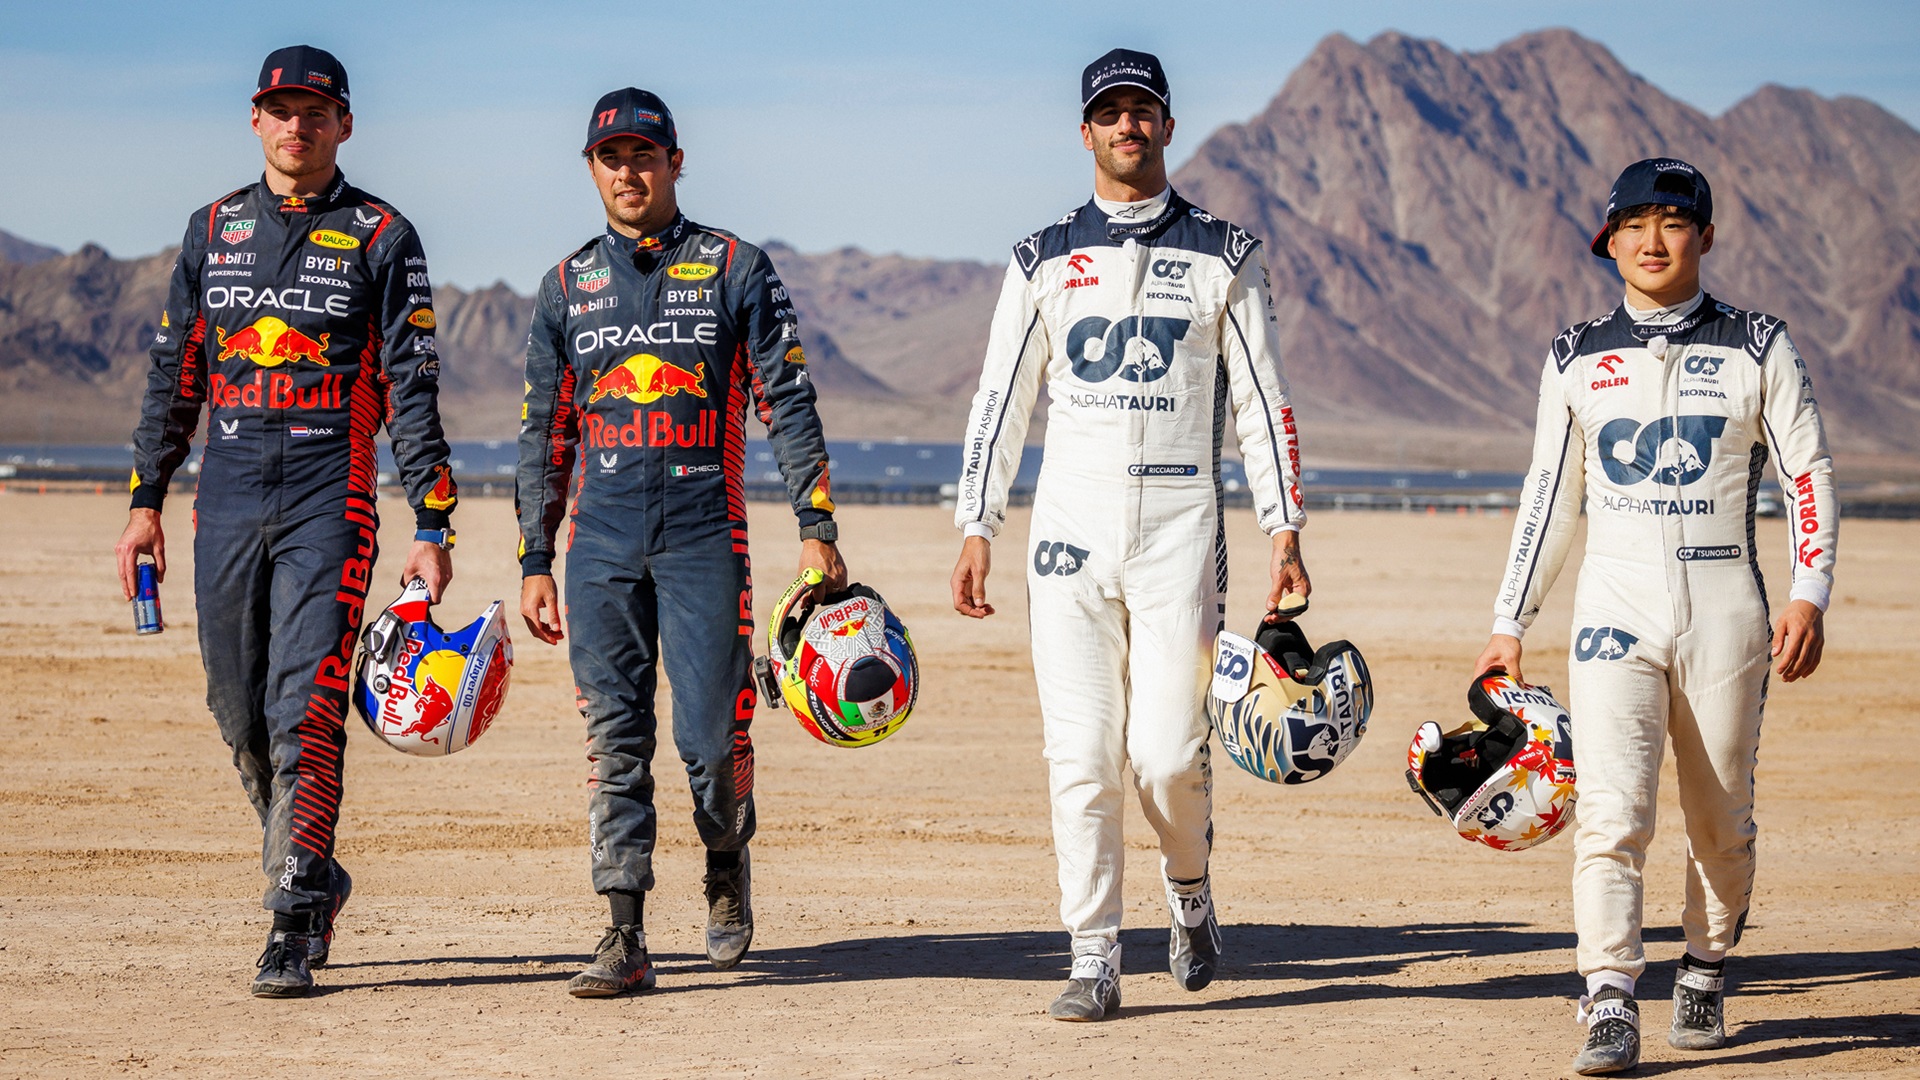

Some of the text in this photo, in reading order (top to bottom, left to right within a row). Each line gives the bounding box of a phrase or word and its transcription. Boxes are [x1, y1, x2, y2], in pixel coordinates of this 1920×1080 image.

[270, 68, 283, 86] 1
[1101, 68, 1151, 80] ALPHATAURI
[598, 108, 618, 129] 11
[227, 222, 252, 230] TAG
[222, 231, 252, 243] HEUER
[322, 235, 354, 247] RAUCH
[208, 253, 255, 265] Mobil 1
[305, 255, 351, 273] BYBIT
[582, 271, 608, 281] TAG
[680, 267, 711, 275] RAUCH
[299, 275, 351, 289] HONDA
[577, 278, 609, 291] HEUER
[1064, 276, 1099, 290] ORLEN
[1150, 280, 1186, 289] ALPHATAURI
[206, 286, 351, 318] ORACLE
[667, 287, 713, 303] BYBIT
[1146, 292, 1193, 304] HONDA
[569, 297, 616, 317] Mobil 1
[663, 308, 717, 316] HONDA
[575, 321, 718, 355] ORACLE
[182, 343, 198, 368] YOU
[209, 369, 264, 409] Red
[268, 372, 344, 409] Bull
[1591, 376, 1629, 391] ORLEN
[1069, 394, 1175, 412] ALPHATAURI
[1679, 389, 1727, 399] HONDA
[552, 405, 571, 431] YOU
[584, 409, 717, 448] Red Bull
[965, 389, 999, 513] ALPHATAURI.FASHION
[1281, 406, 1302, 479] ORLEN
[687, 464, 720, 473] CHECO
[1148, 466, 1185, 474] RICCIARDO
[1602, 496, 1715, 516] ALPHATAURI
[1795, 472, 1819, 535] ORLEN
[1503, 469, 1551, 607] ALPHATAURI.FASHION
[1696, 549, 1730, 558] TSUNODA
[314, 498, 377, 692] Red Bull
[819, 599, 869, 629] Red Bull
[884, 627, 907, 646] telcel
[467, 657, 484, 694] Player
[809, 656, 824, 683] Claro
[383, 637, 424, 727] Red Bull
[810, 700, 845, 740] BANORTE
[1518, 752, 1536, 762] ORLEN
